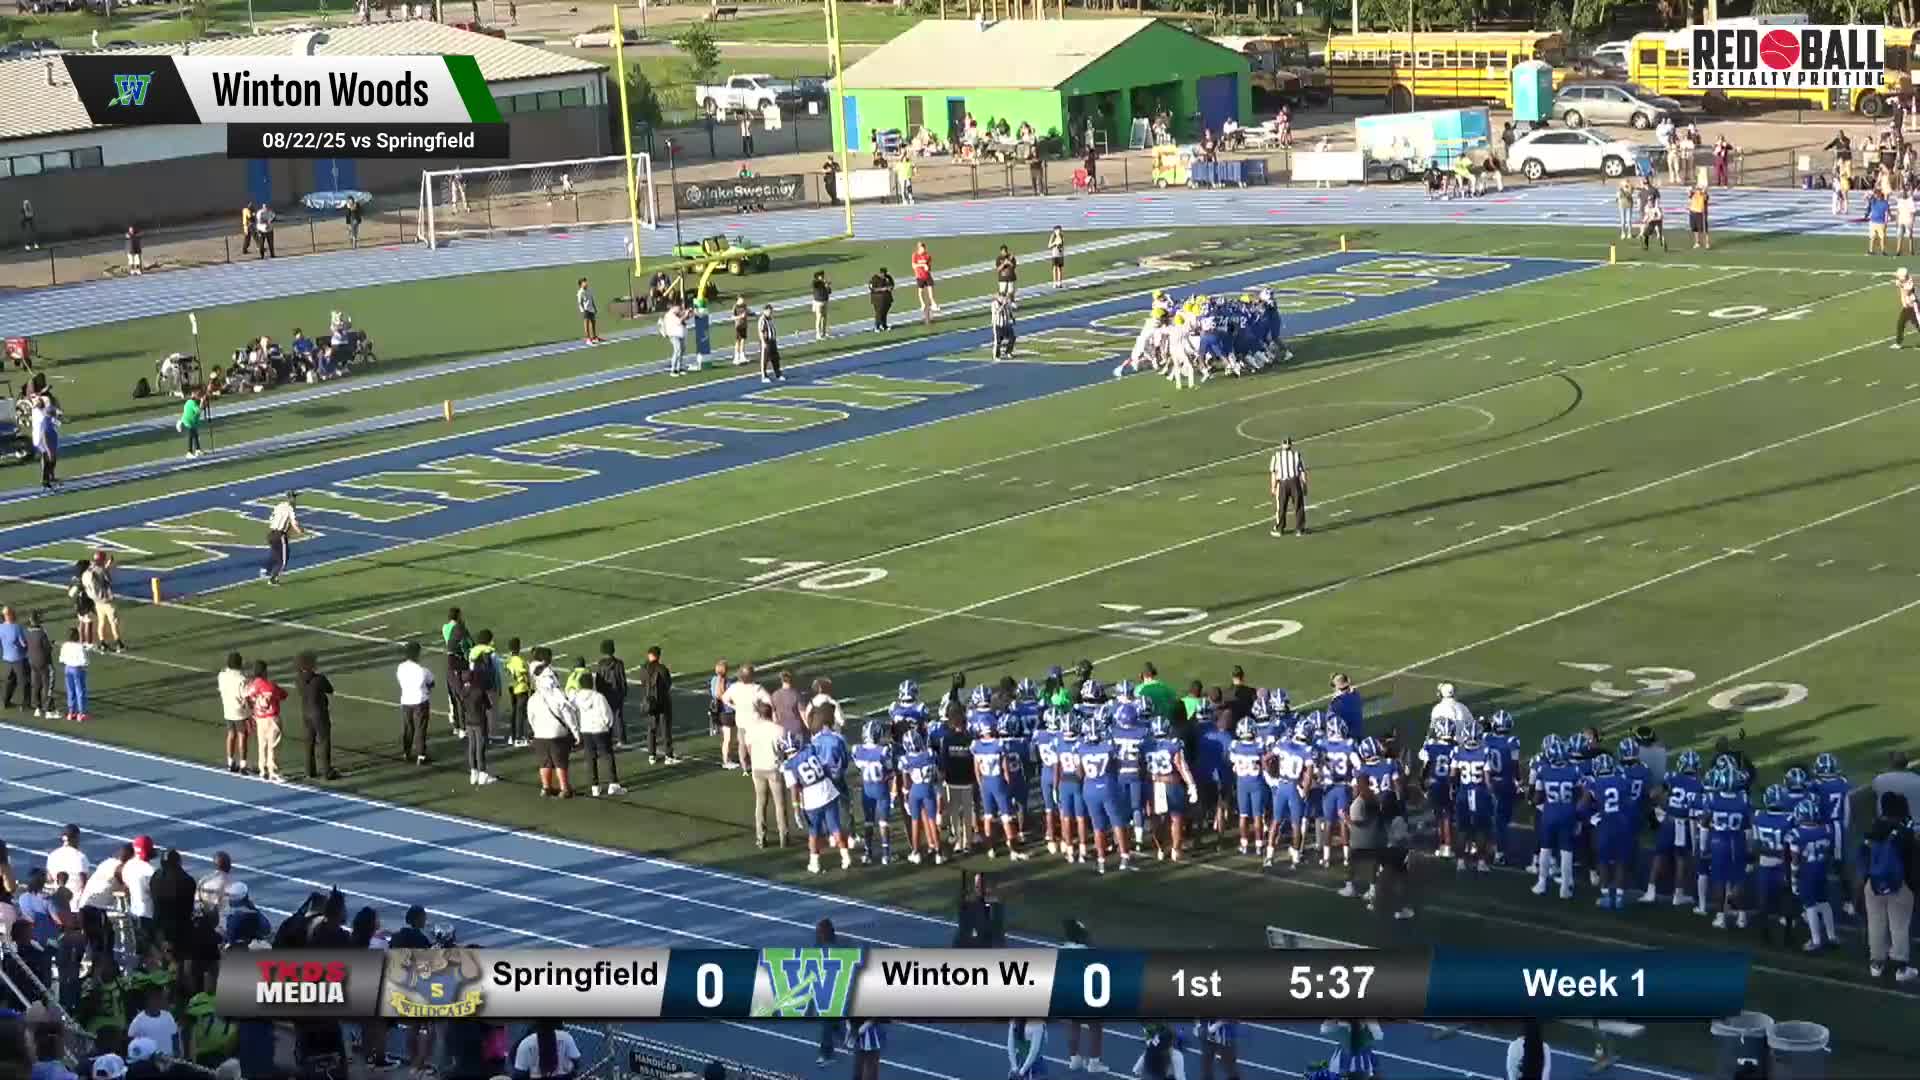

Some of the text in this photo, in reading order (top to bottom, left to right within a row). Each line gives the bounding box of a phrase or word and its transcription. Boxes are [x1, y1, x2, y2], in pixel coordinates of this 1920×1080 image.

[0, 374, 984, 571] WINTON
[1097, 606, 1304, 646] 20
[1590, 666, 1809, 713] 30
[1081, 752, 1110, 779] 67
[1458, 760, 1486, 785] 35
[1544, 781, 1574, 804] 56
[1603, 787, 1620, 813] 2
[1829, 792, 1843, 819] 7
